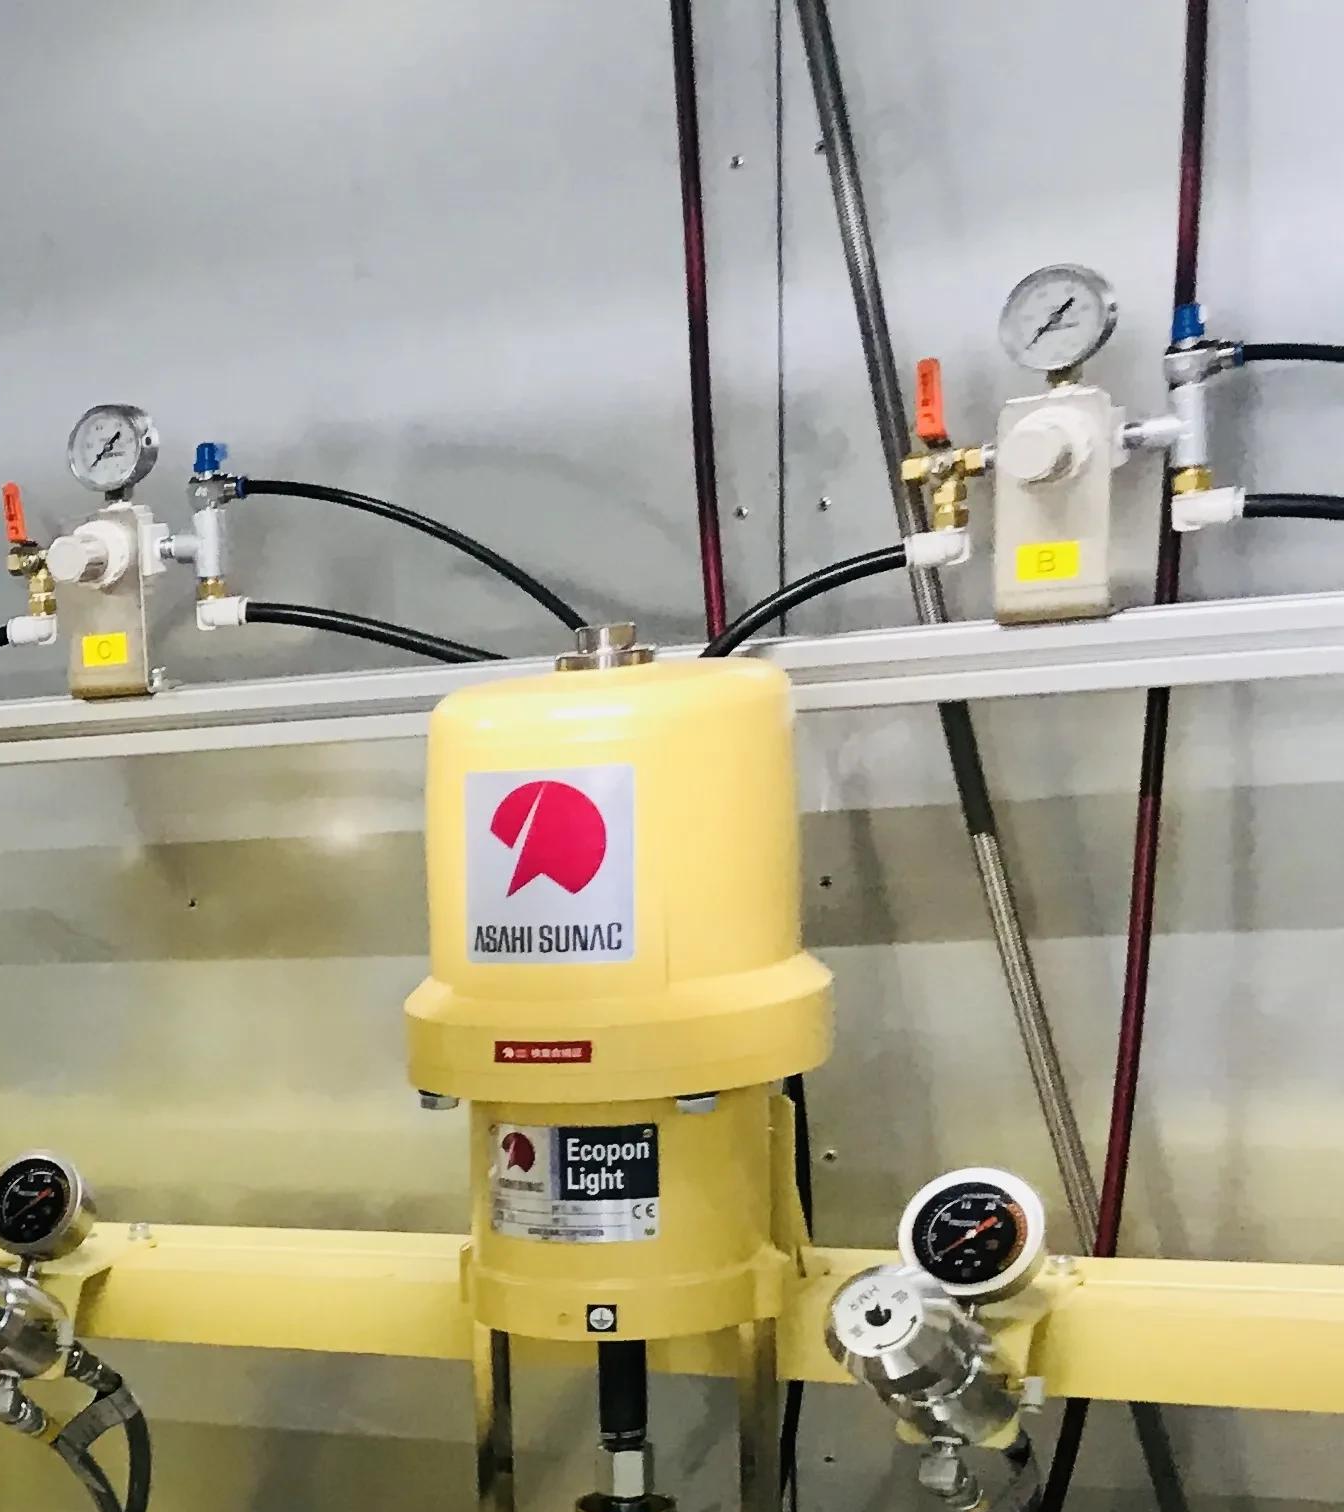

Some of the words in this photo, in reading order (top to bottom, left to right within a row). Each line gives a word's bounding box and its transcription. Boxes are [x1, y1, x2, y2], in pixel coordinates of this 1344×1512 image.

[1037, 549, 1057, 573] B
[97, 640, 112, 660] C
[474, 924, 532, 953] ASAHI
[539, 922, 623, 953] SUNAC
[566, 1137, 651, 1167] Ecopon
[566, 1166, 625, 1196] Light
